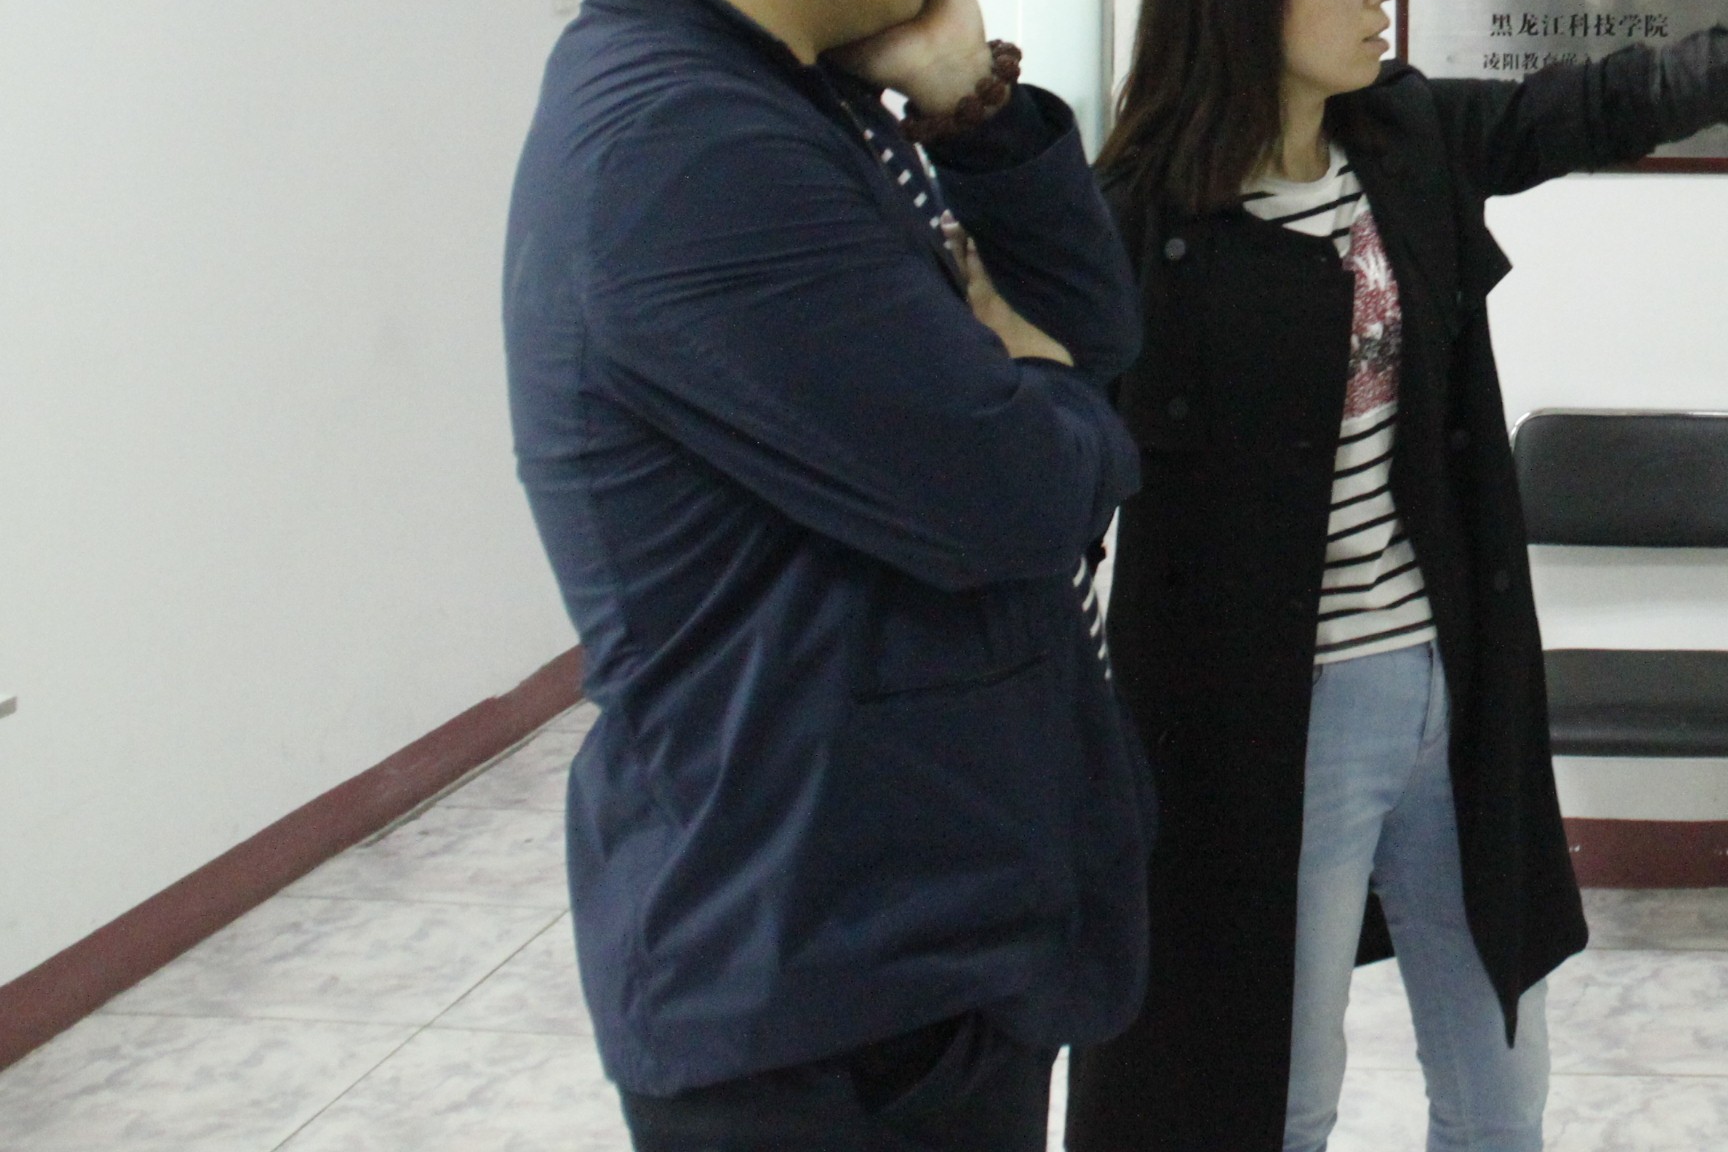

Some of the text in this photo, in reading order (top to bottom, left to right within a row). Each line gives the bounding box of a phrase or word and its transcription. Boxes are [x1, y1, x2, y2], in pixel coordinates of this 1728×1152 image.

[1490, 12, 1670, 38] 黑龙江科技学院
